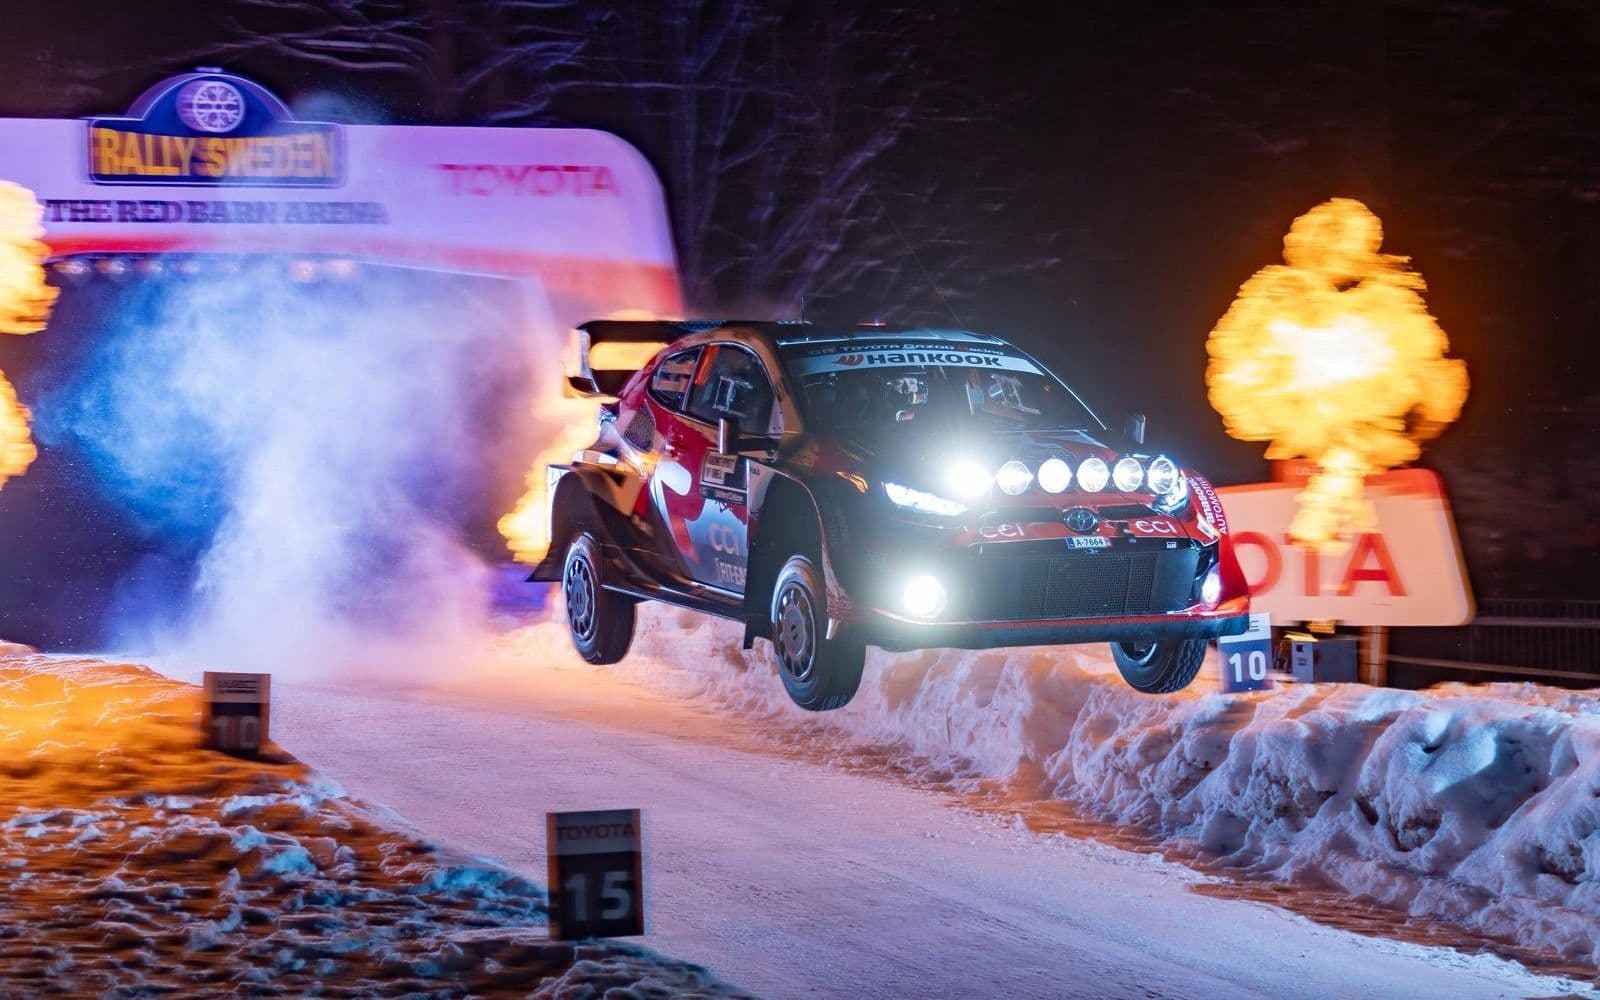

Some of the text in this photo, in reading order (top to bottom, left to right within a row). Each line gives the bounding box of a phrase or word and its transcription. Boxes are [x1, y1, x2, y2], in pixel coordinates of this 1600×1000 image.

[92, 128, 338, 177] RALLY SWEDEN
[438, 164, 619, 197] TOYOTA
[46, 200, 112, 222] THE
[116, 200, 183, 223] RED
[187, 200, 276, 223] BARN
[841, 343, 899, 352] TOYOTA
[866, 353, 1002, 366] Hankook
[1232, 531, 1408, 597] OTA
[1229, 651, 1267, 683] 10
[557, 823, 636, 841] TOYOTA
[564, 871, 631, 921] 15
